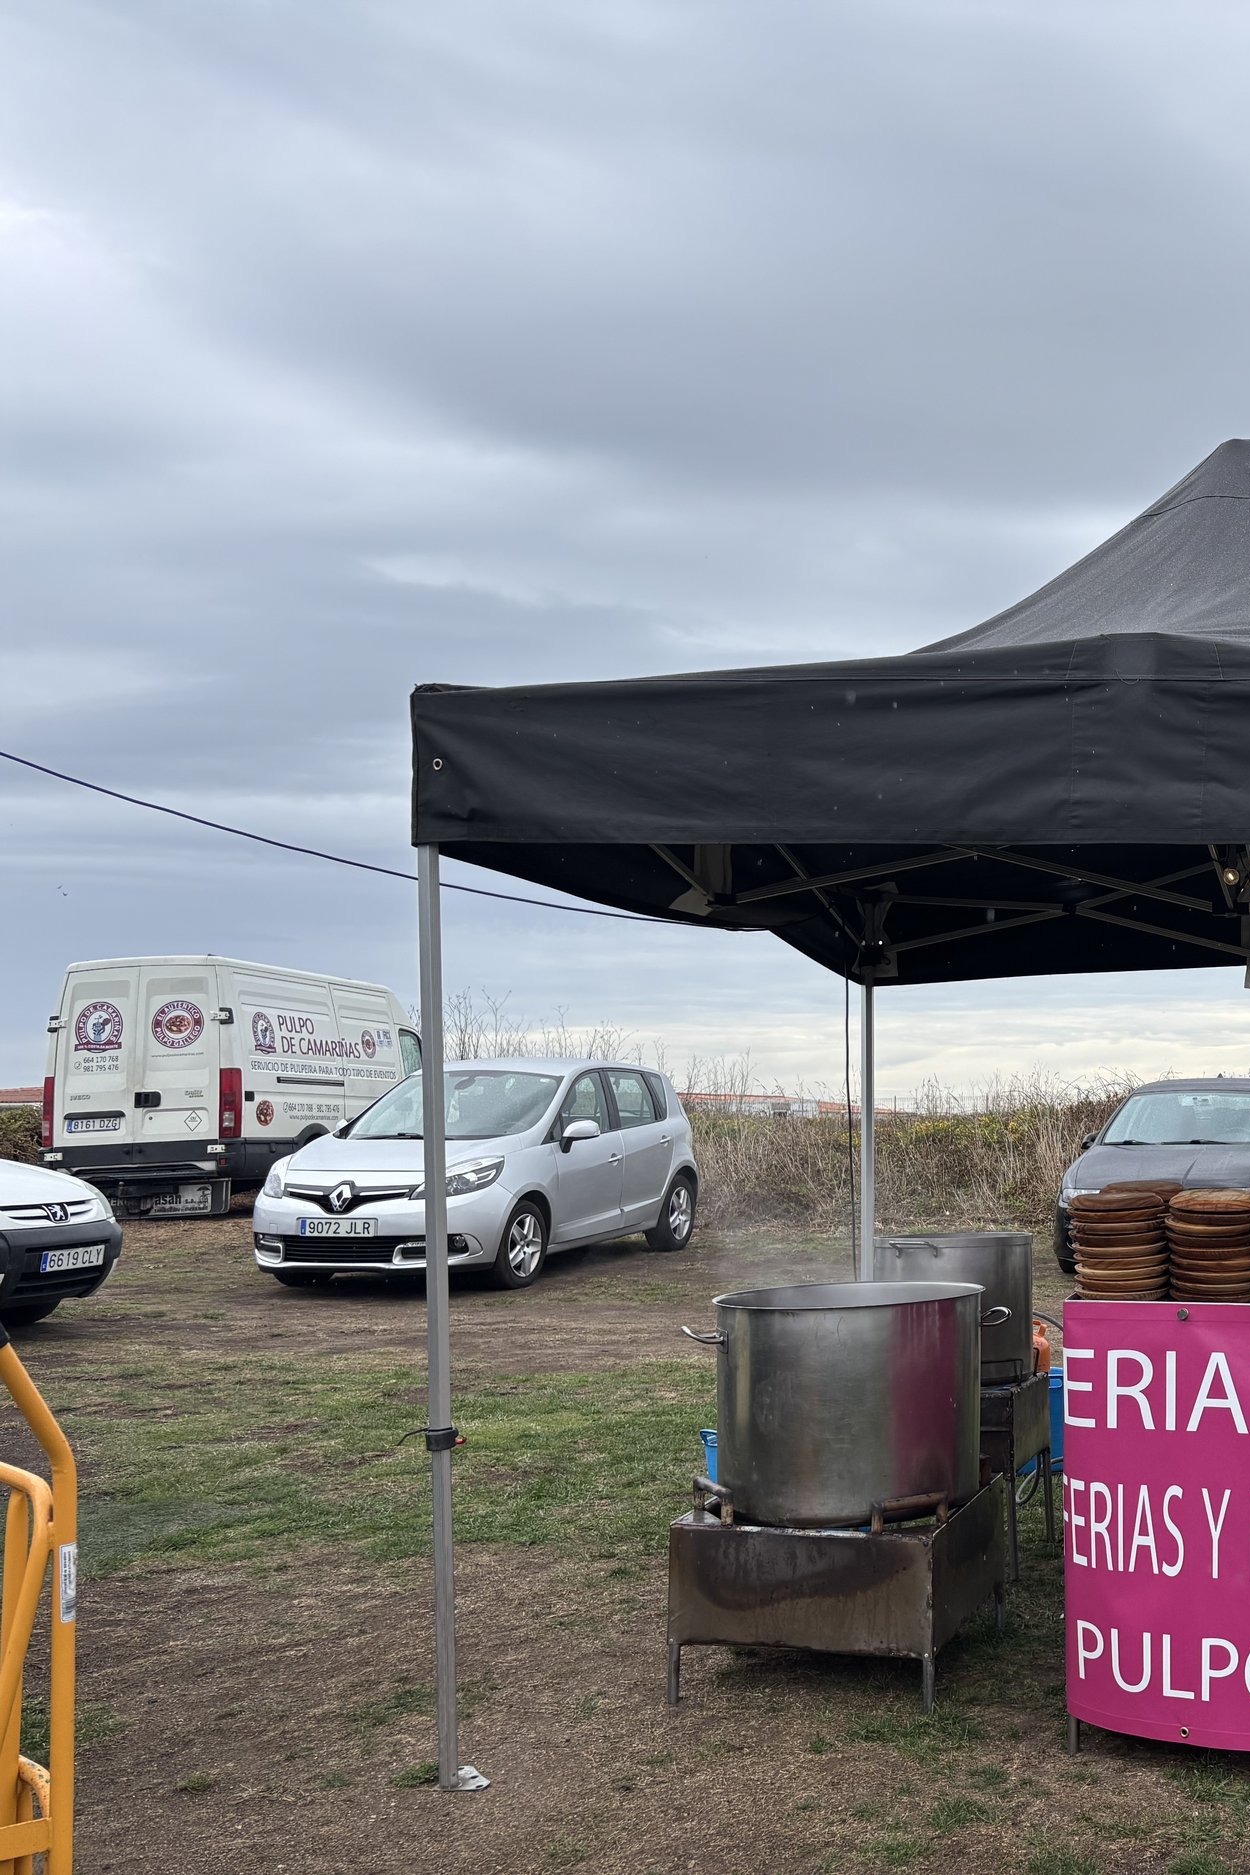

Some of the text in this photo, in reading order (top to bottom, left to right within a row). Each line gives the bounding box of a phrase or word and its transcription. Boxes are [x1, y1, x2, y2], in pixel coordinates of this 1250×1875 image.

[79, 1016, 88, 1043] PULPO
[85, 1006, 95, 1016] DE
[277, 1014, 314, 1035] PULPO
[155, 1025, 200, 1046] PULPO GALLEGO
[281, 1036, 297, 1054] DE
[299, 1037, 361, 1059] CAMARIÑAS
[83, 1065, 94, 1073] 981
[95, 1064, 107, 1072] 795
[250, 1060, 397, 1080] SERVICIO DE PULPEIRA PARA TODO TIPO DE EVENTOS
[73, 1119, 118, 1130] 8161 DZG
[308, 1222, 371, 1234] 9072 JLR
[49, 1248, 103, 1268] 6619 CLY
[1201, 1487, 1232, 1579] Y
